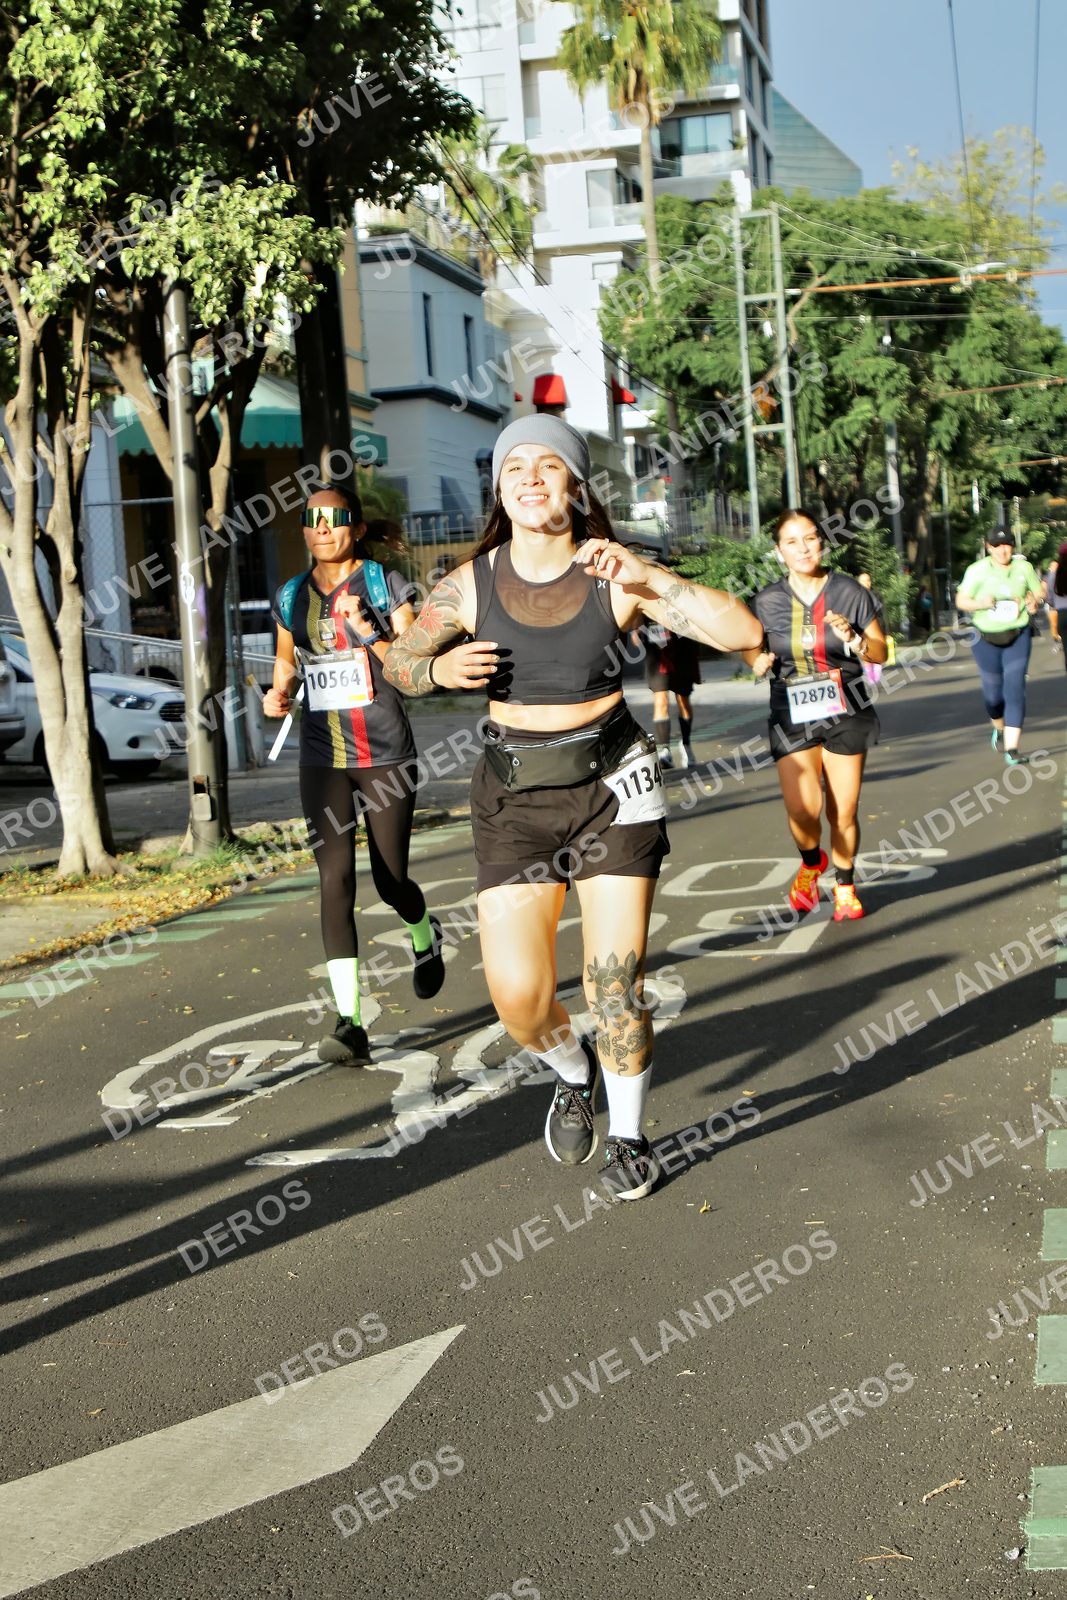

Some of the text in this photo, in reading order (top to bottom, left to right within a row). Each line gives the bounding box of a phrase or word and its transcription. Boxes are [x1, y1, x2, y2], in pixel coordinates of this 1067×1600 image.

[308, 668, 361, 690] 10564
[791, 685, 837, 706] 12878
[615, 761, 664, 799] 1134
